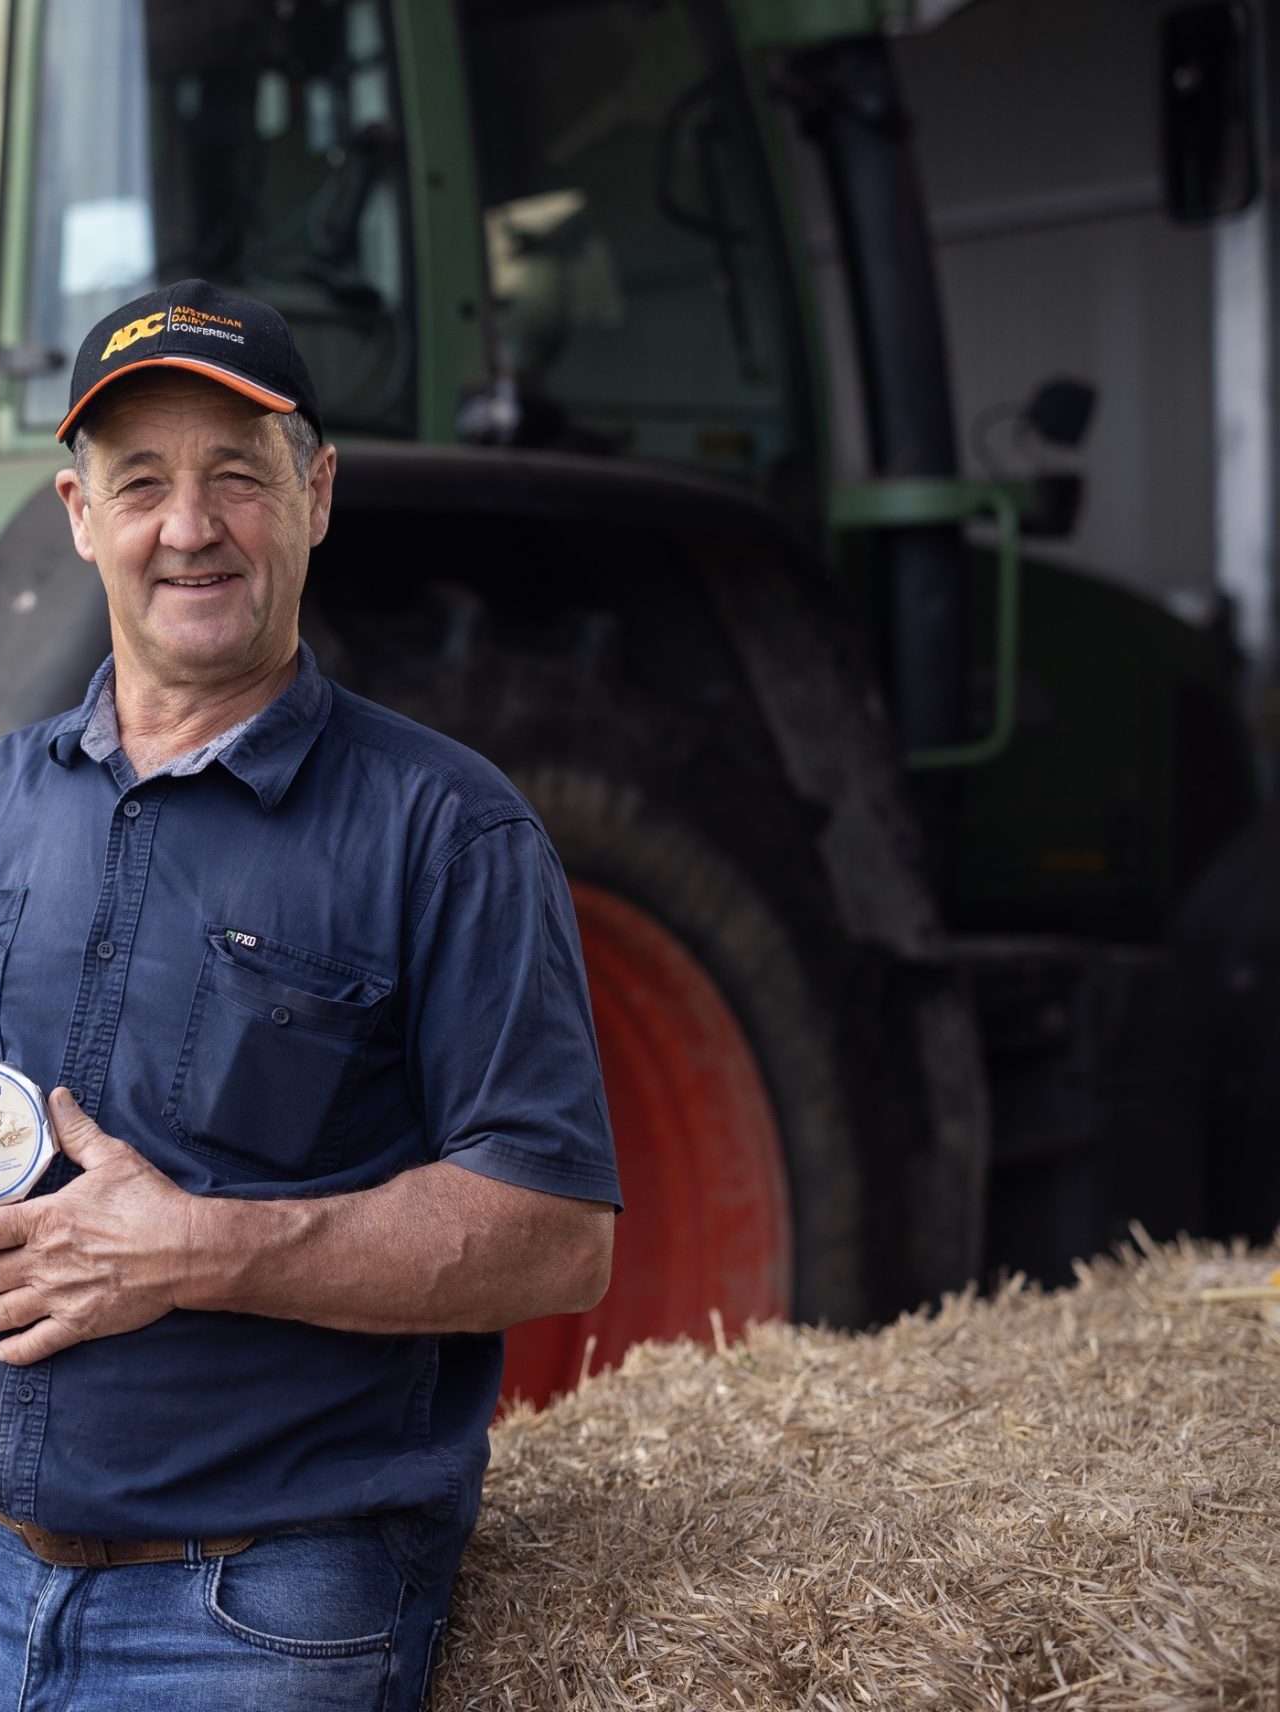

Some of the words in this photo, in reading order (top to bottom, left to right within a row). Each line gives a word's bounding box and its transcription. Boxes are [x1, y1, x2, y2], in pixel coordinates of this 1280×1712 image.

[171, 313, 206, 327] DAIRY
[173, 306, 242, 329] AUSTRALIAN
[100, 312, 167, 361] ADC
[171, 323, 245, 344] CONFERENCE
[235, 932, 257, 947] FXD
